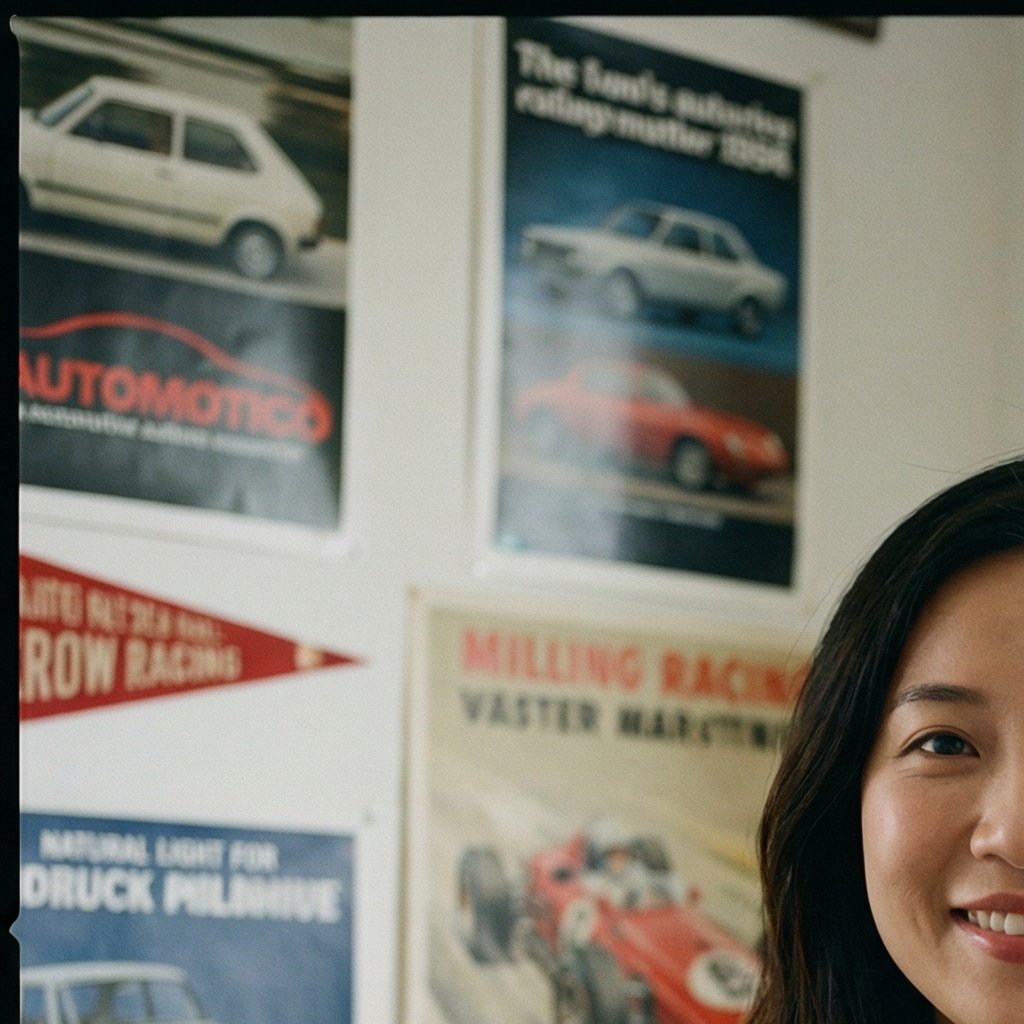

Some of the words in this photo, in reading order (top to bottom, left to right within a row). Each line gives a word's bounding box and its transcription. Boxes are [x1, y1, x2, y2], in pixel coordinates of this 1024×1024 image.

[460, 625, 645, 694] MILLING
[155, 834, 227, 870] LIGHT
[228, 839, 280, 873] FOR
